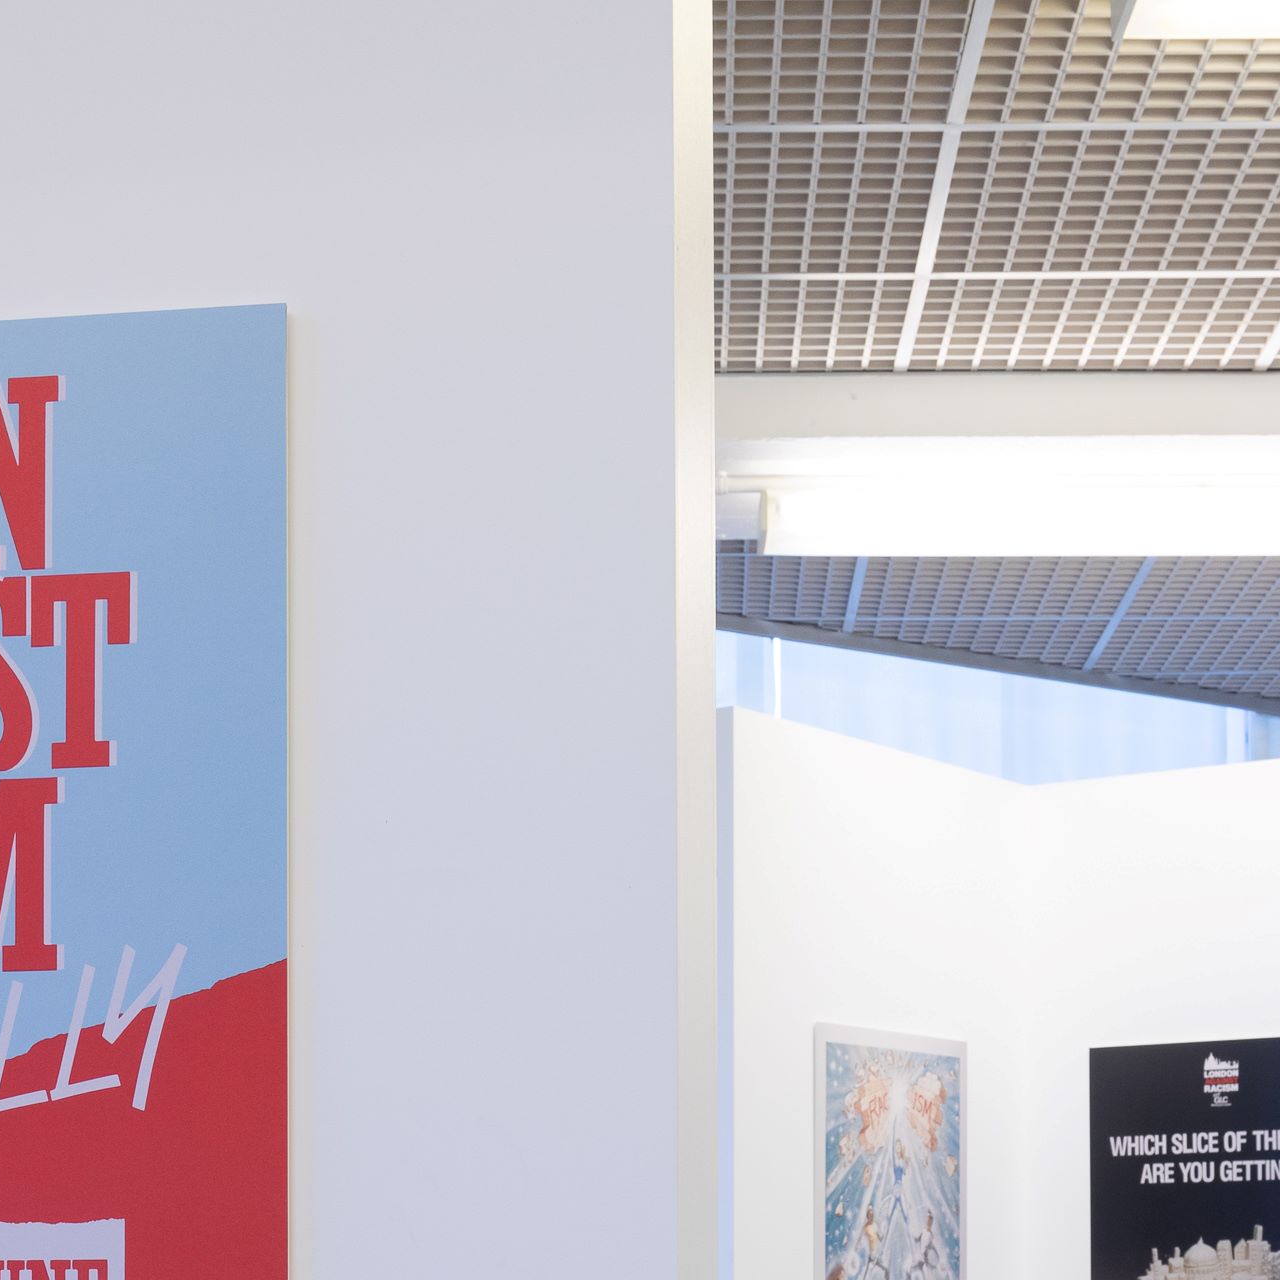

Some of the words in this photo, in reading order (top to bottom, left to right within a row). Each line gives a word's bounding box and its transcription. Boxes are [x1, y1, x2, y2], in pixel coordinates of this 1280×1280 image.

[1204, 1070, 1239, 1079] LONDON
[1204, 1084, 1239, 1093] RACISM
[1110, 1134, 1167, 1157] WHICH
[1171, 1132, 1219, 1155] SLICE
[1223, 1131, 1247, 1152] OF
[1140, 1163, 1174, 1184] ARE
[1179, 1161, 1215, 1183] YOU
